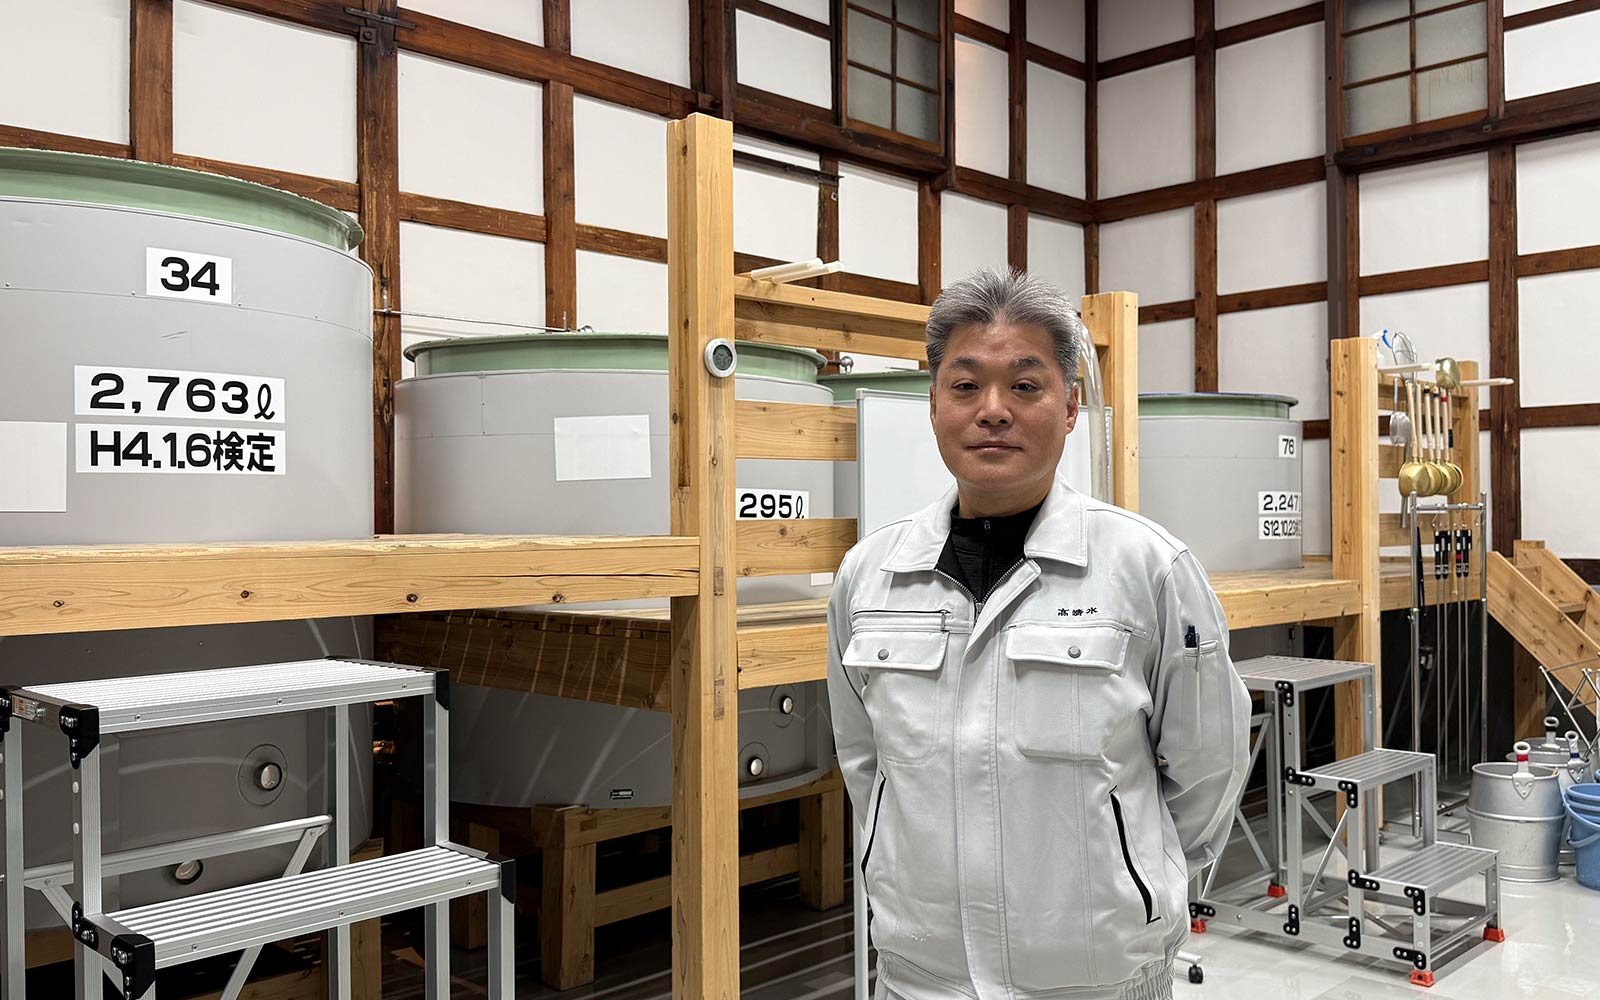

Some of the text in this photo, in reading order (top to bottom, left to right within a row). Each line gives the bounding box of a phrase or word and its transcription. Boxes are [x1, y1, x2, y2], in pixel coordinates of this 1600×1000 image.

[160, 257, 220, 296] 34
[89, 430, 276, 472] H4.1.6検定
[1281, 438, 1295, 455] 76
